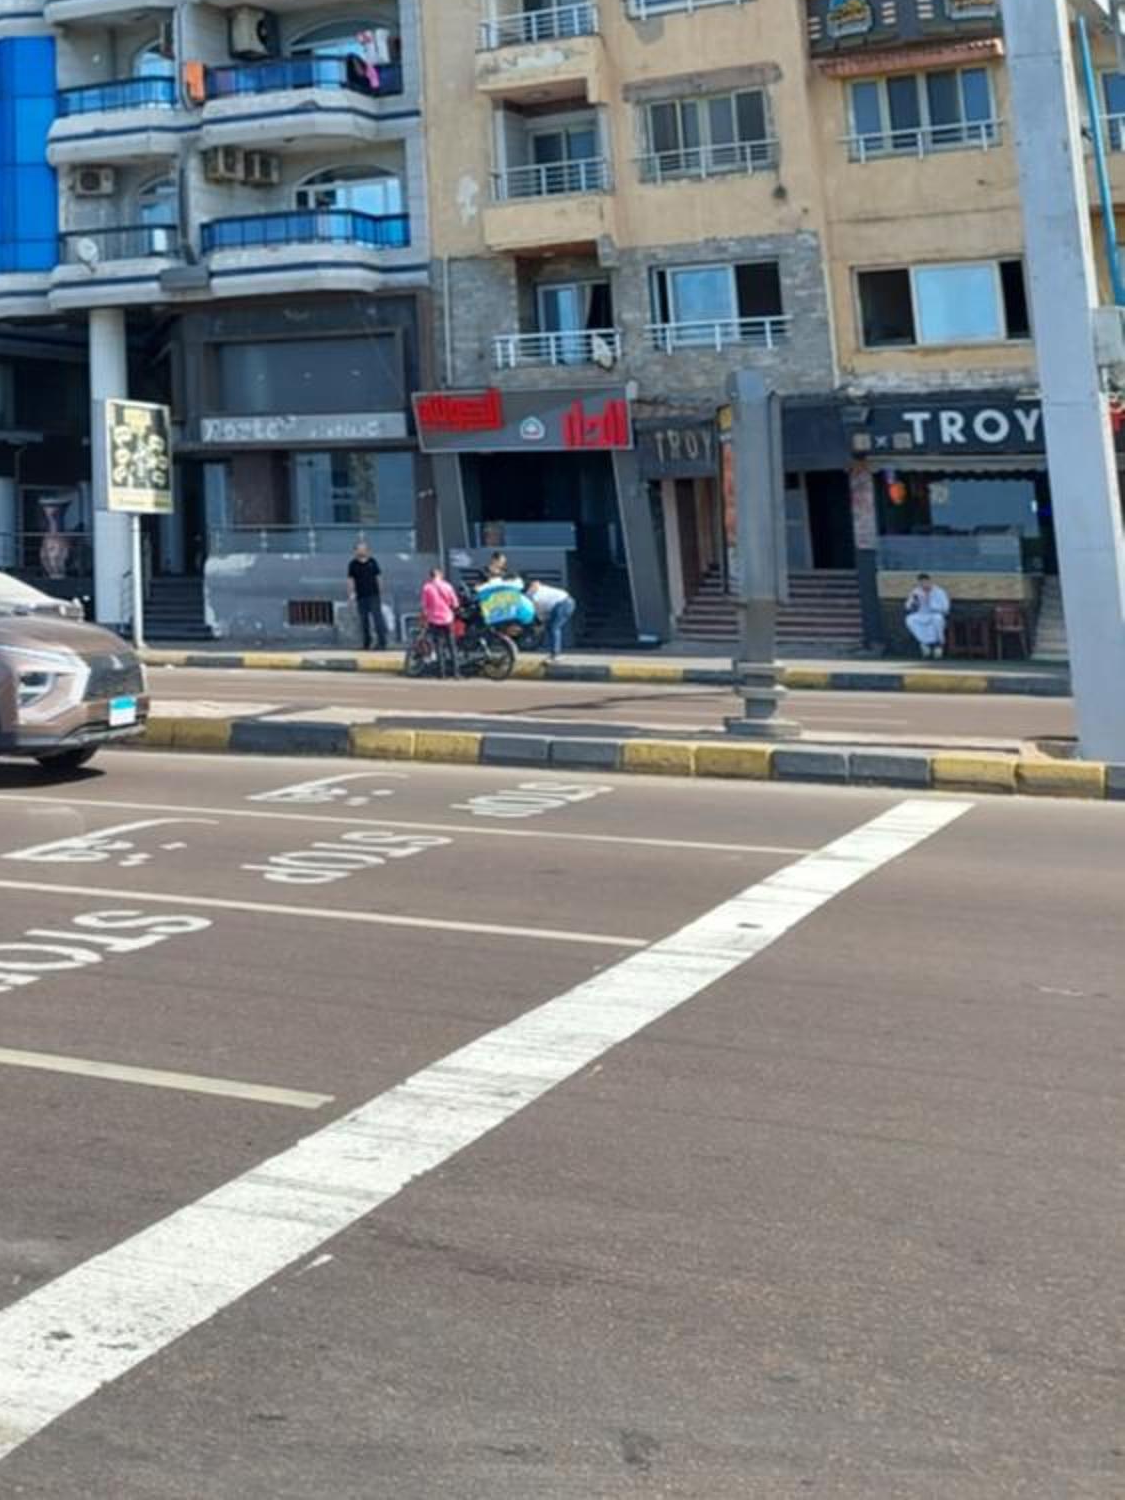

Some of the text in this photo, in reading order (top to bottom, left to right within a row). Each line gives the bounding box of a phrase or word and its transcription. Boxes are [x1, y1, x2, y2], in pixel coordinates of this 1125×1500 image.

[901, 408, 1040, 445] TROY
[654, 427, 712, 466] TROY
[450, 780, 614, 818] STOP
[240, 830, 454, 884] STOP
